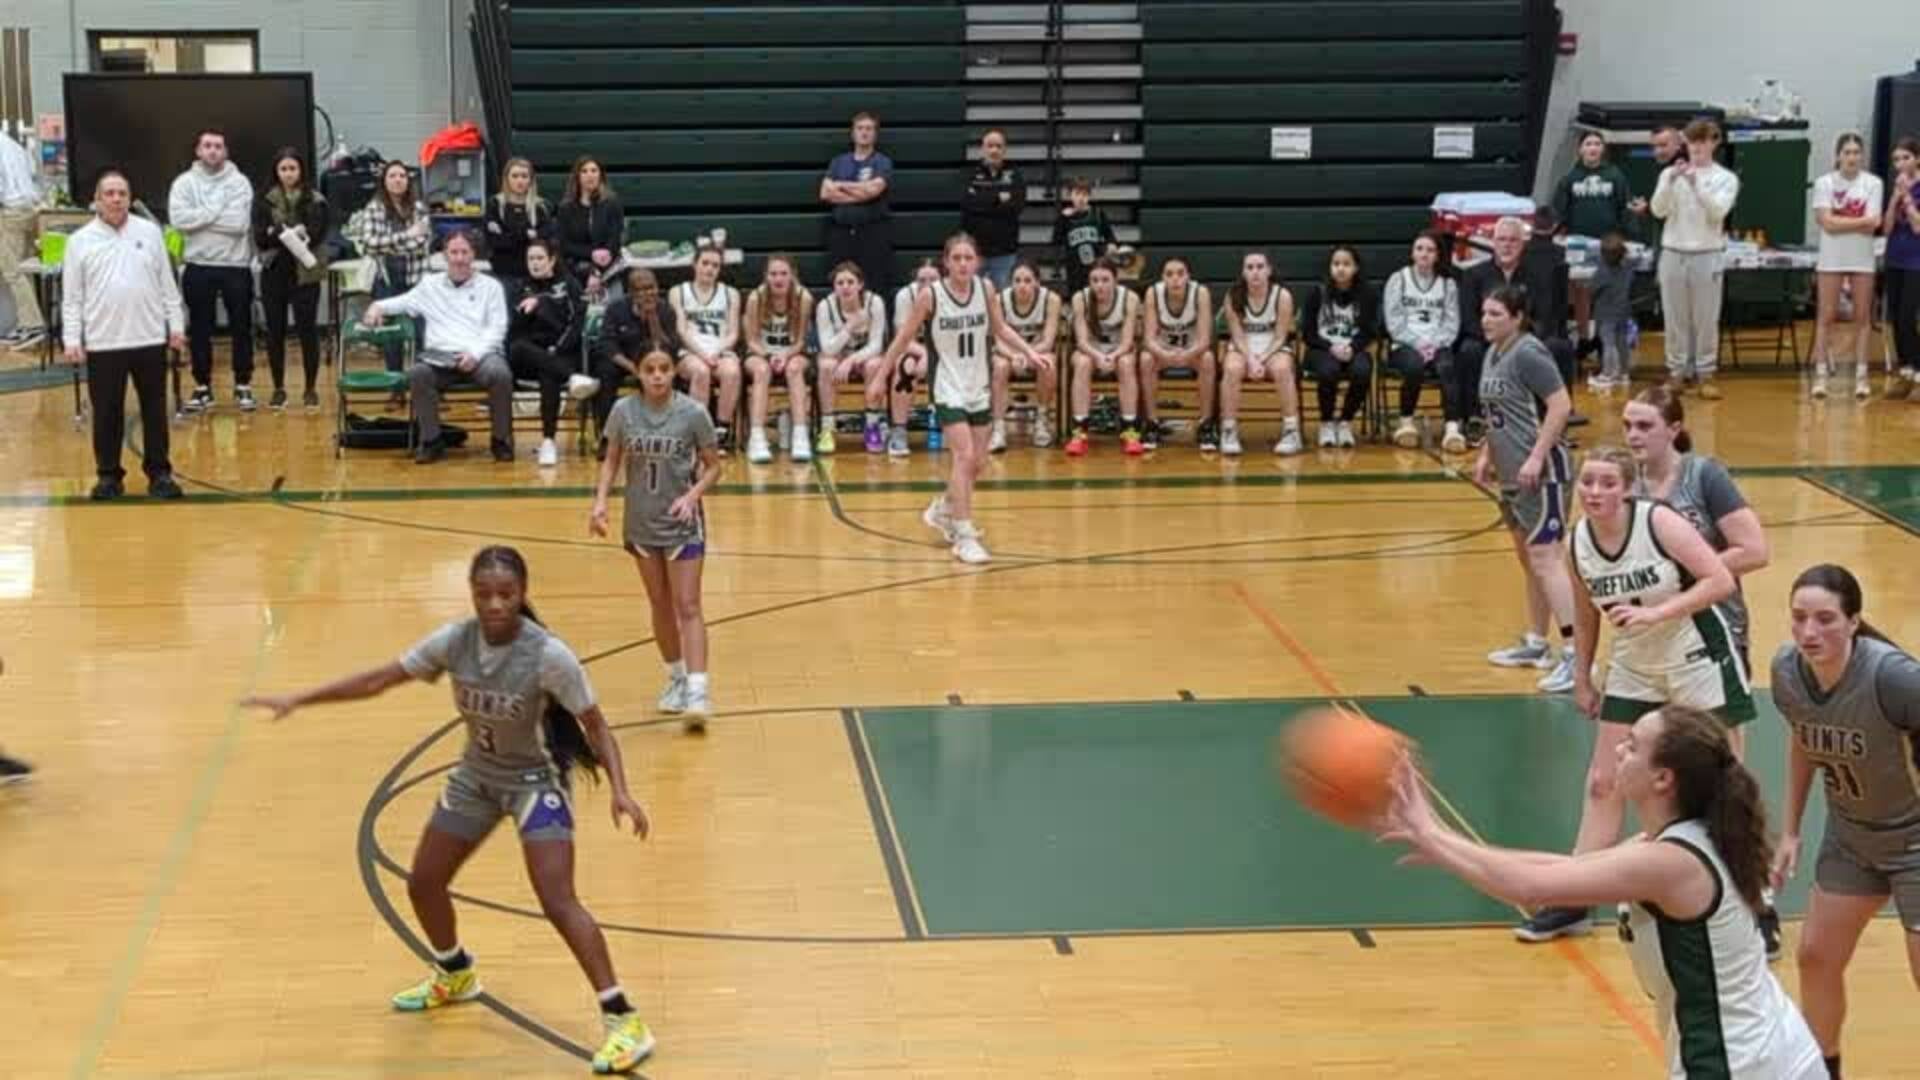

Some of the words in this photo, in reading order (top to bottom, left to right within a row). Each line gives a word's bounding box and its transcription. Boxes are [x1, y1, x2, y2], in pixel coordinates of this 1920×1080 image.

[959, 332, 974, 358] 11
[646, 459, 658, 494] 1
[477, 722, 497, 754] 3
